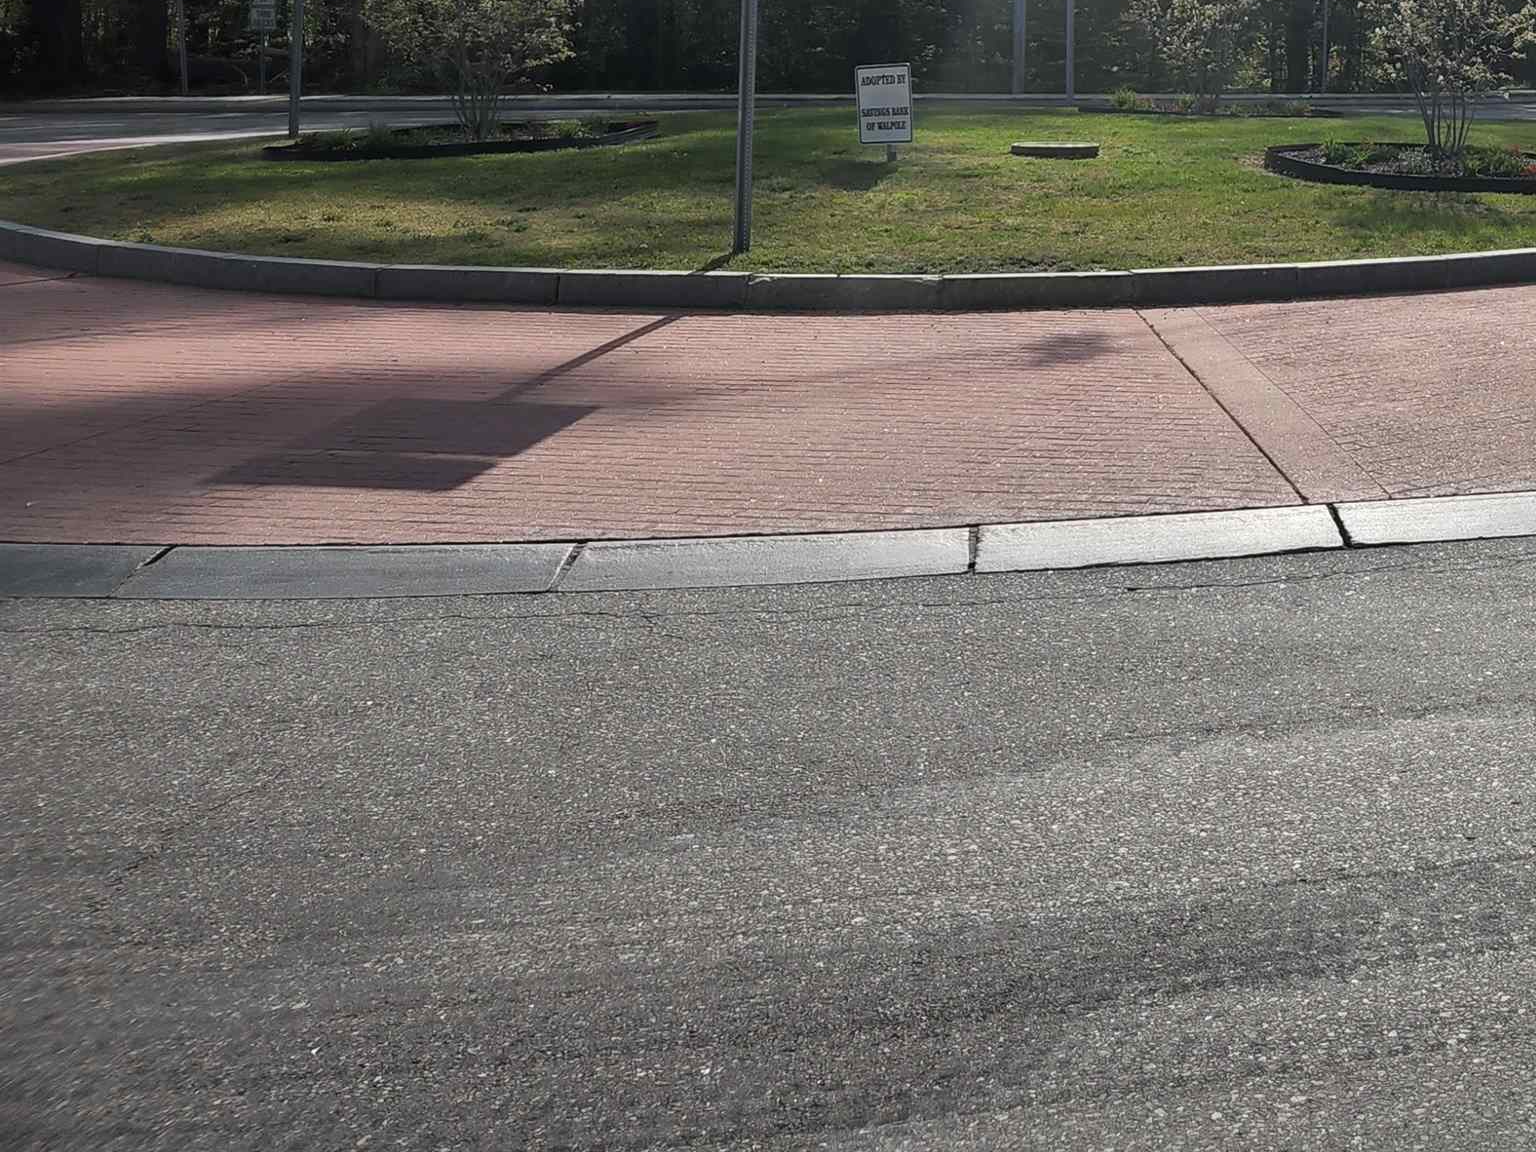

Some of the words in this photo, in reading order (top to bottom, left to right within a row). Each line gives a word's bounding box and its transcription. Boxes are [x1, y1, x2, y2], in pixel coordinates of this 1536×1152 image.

[861, 74, 895, 86] ADOPTED
[896, 74, 906, 84] BY
[861, 107, 890, 117] SAVINGS
[891, 106, 910, 116] BANK
[866, 122, 875, 131] OF
[876, 120, 907, 130] WALPOLE
